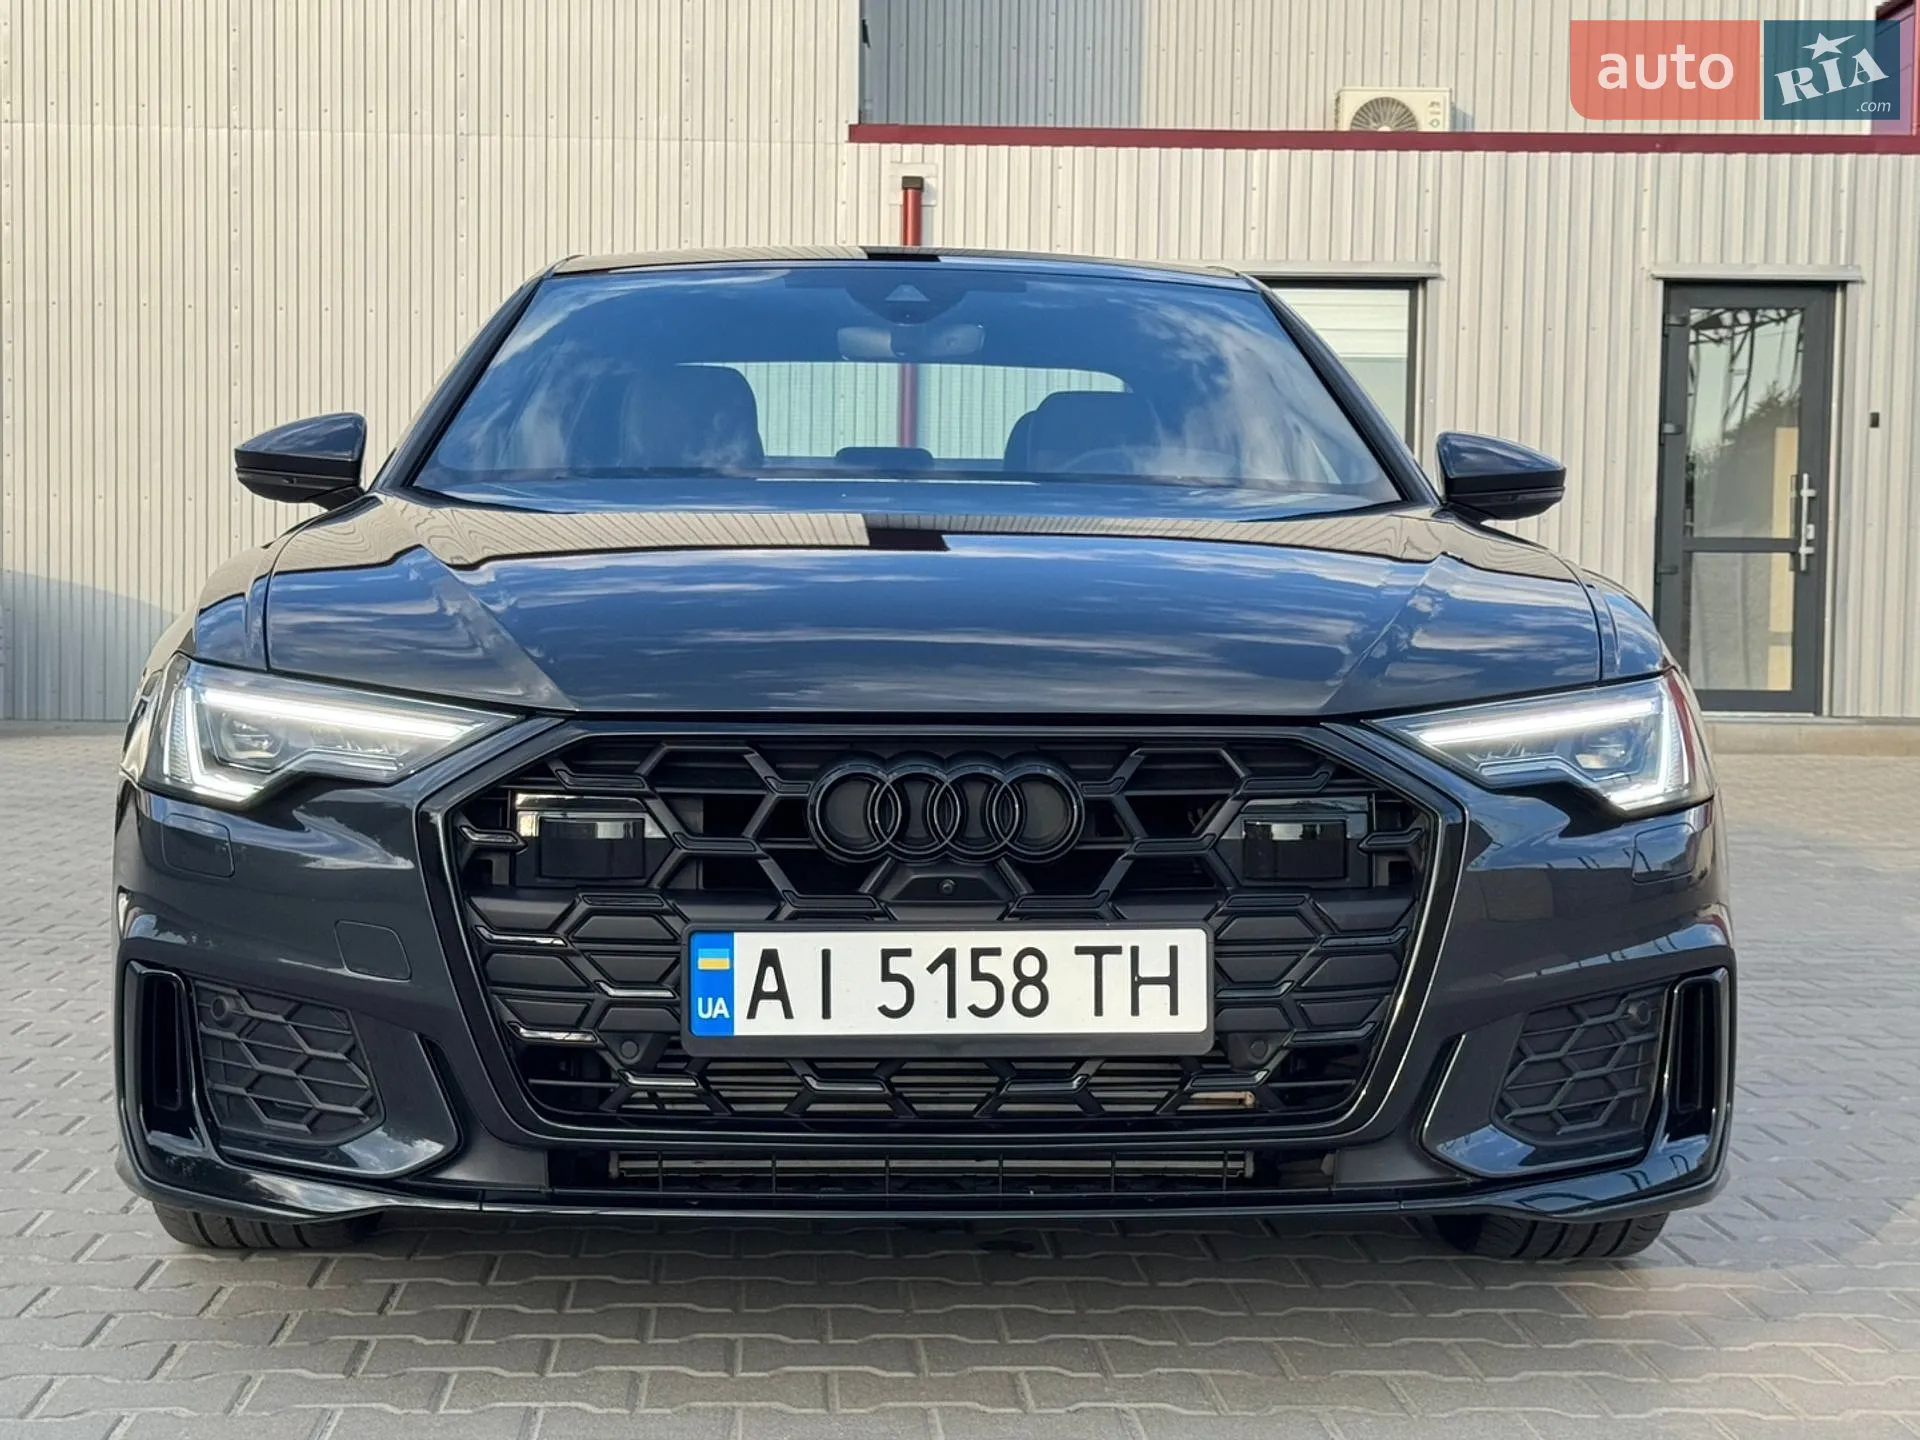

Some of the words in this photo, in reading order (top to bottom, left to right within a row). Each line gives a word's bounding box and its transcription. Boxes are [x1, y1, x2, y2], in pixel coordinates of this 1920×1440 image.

[746, 948, 832, 1020] AI
[877, 946, 1049, 1019] 5158
[1074, 945, 1179, 1017] TH
[697, 997, 730, 1020] UA
